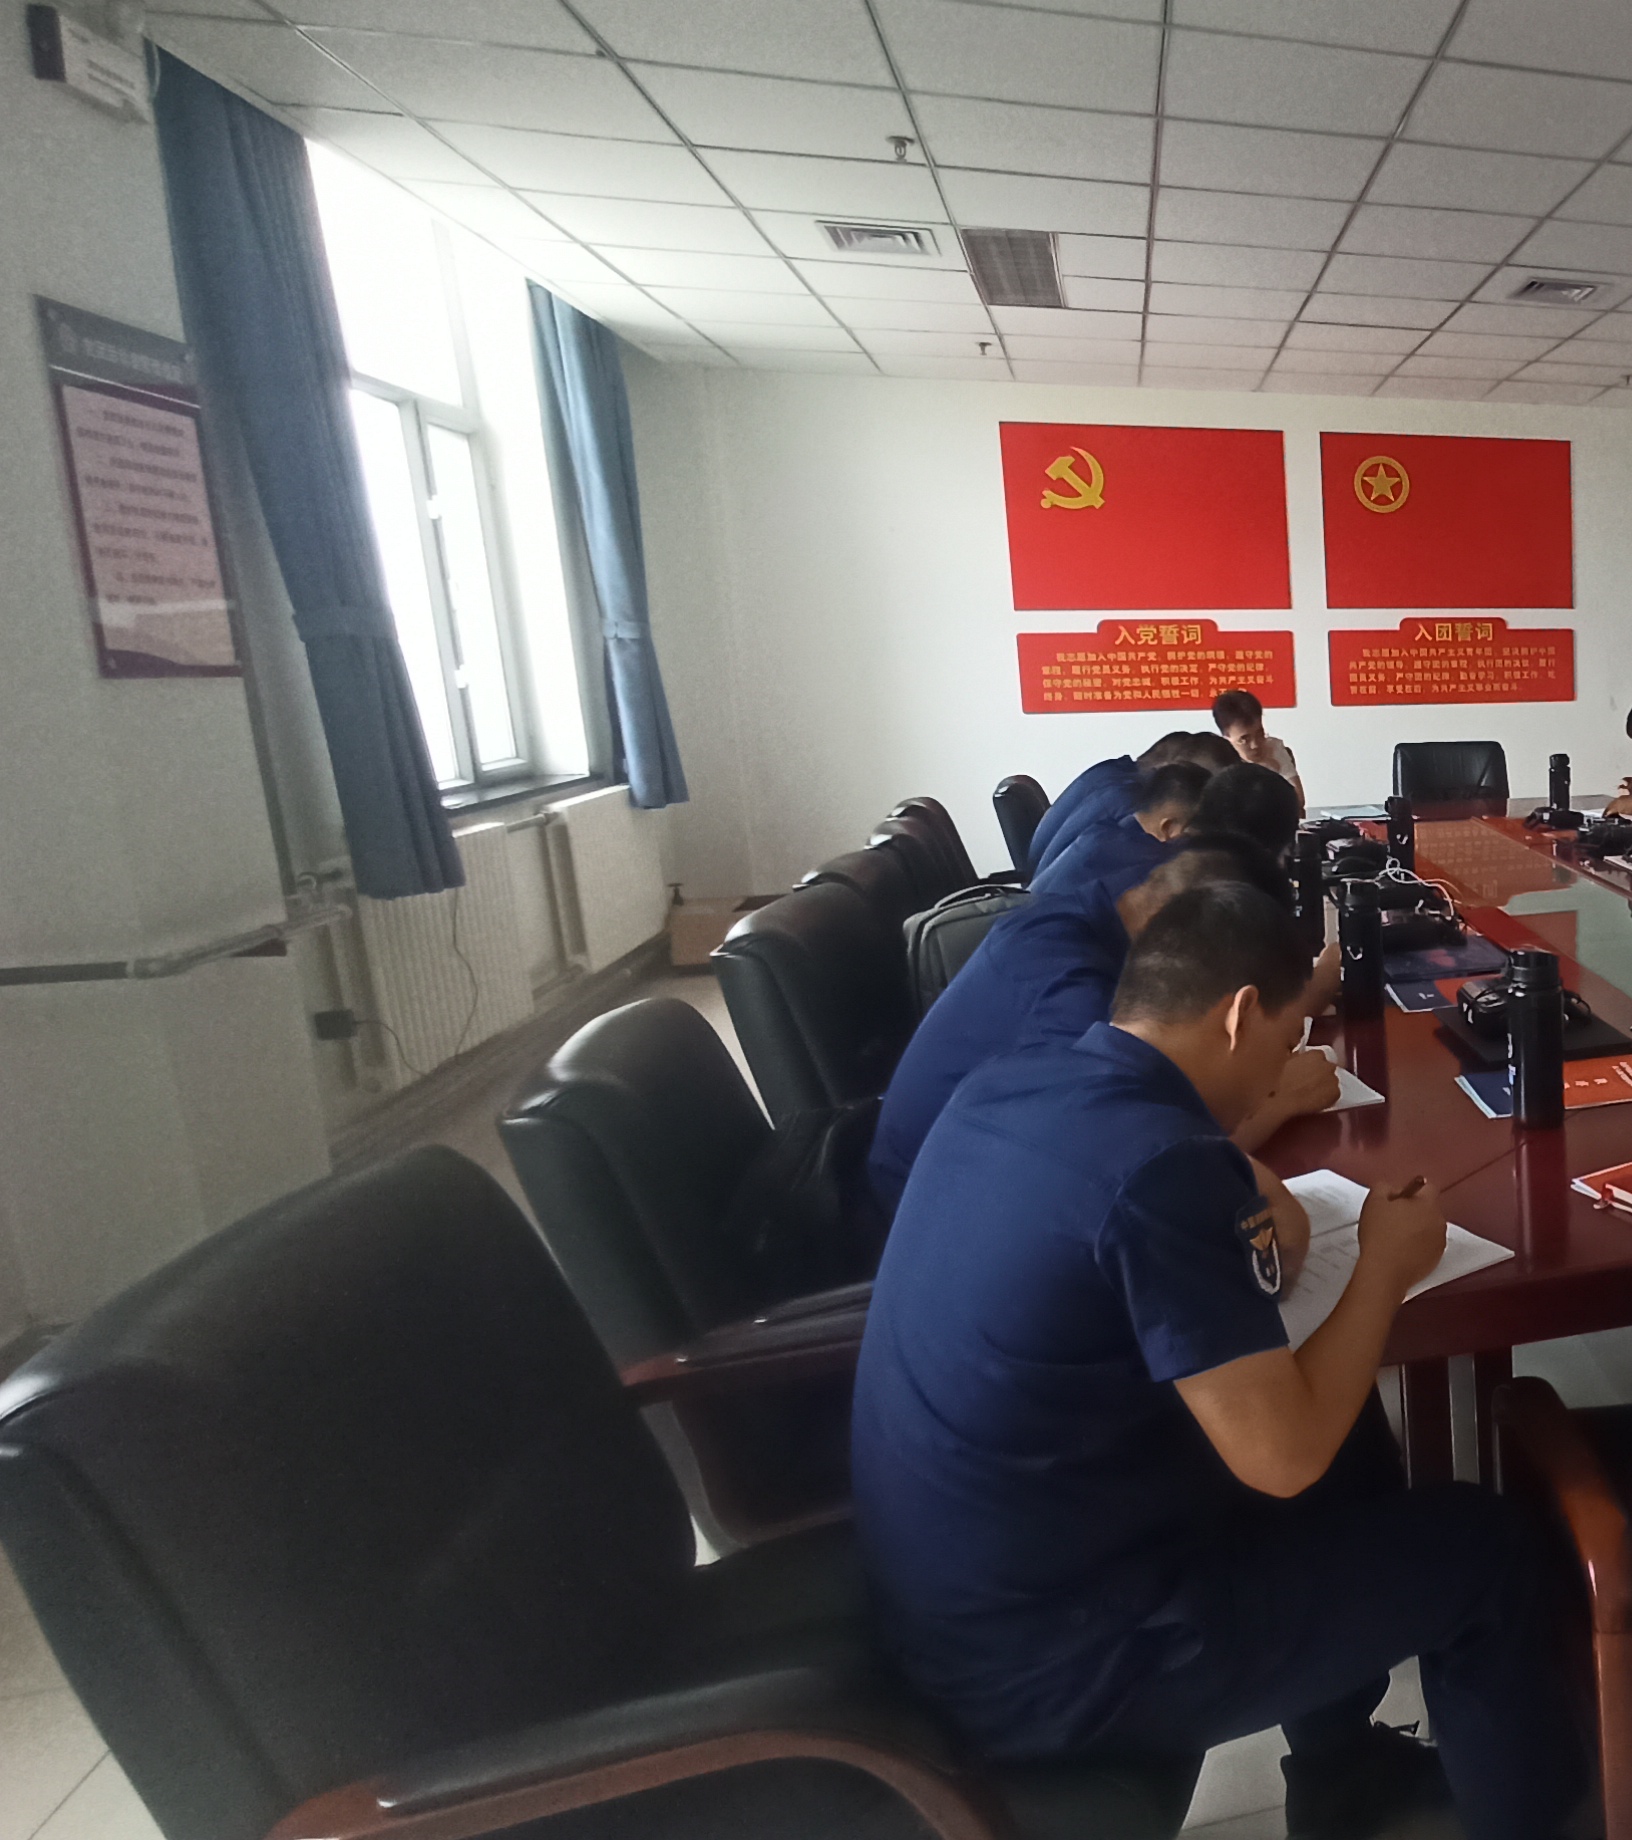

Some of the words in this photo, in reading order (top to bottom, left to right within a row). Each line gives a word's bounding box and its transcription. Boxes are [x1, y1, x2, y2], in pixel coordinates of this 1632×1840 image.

[1114, 624, 1202, 645] 入党誓词
[1415, 622, 1493, 642] 入团誓词
